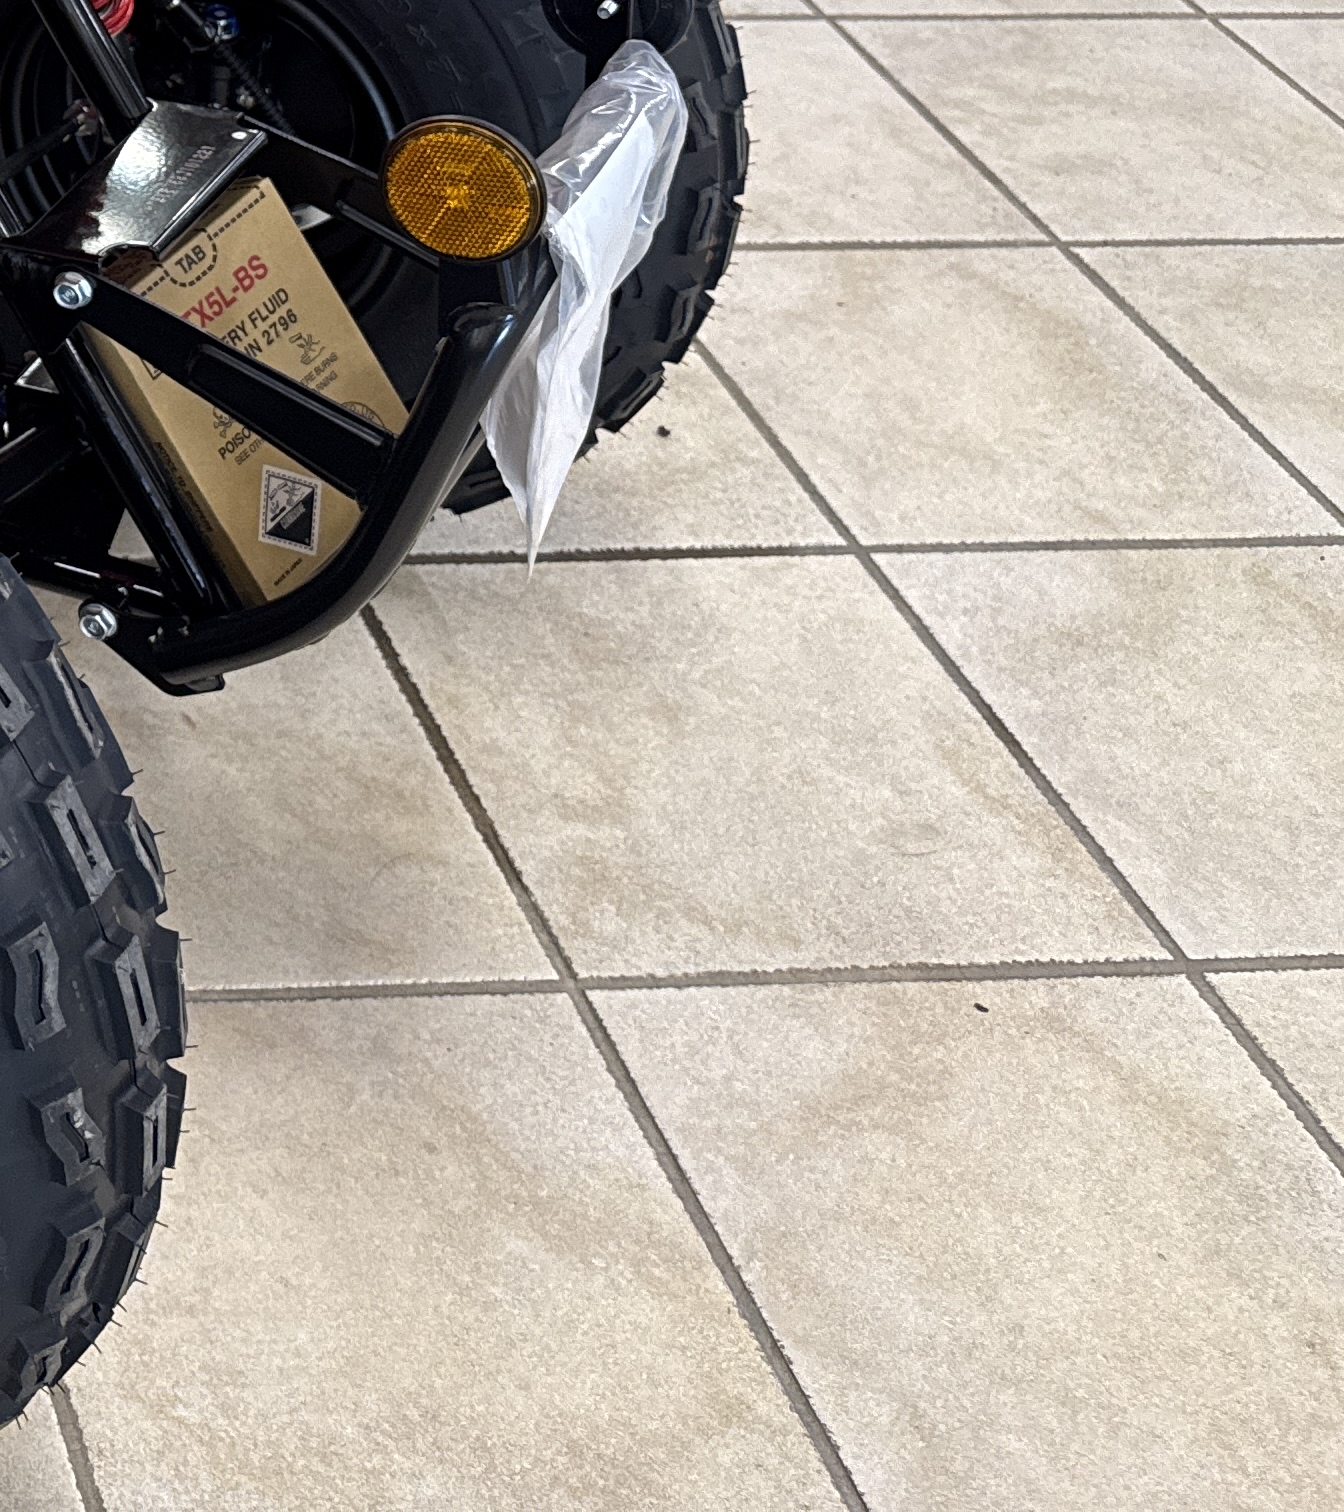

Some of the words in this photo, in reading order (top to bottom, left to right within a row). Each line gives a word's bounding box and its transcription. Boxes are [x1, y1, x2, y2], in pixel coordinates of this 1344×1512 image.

[175, 244, 207, 275] TAB
[180, 254, 269, 329] TX5L-BS
[247, 287, 290, 330] FLUID
[261, 308, 298, 347] 2796
[217, 425, 256, 461] POISO
